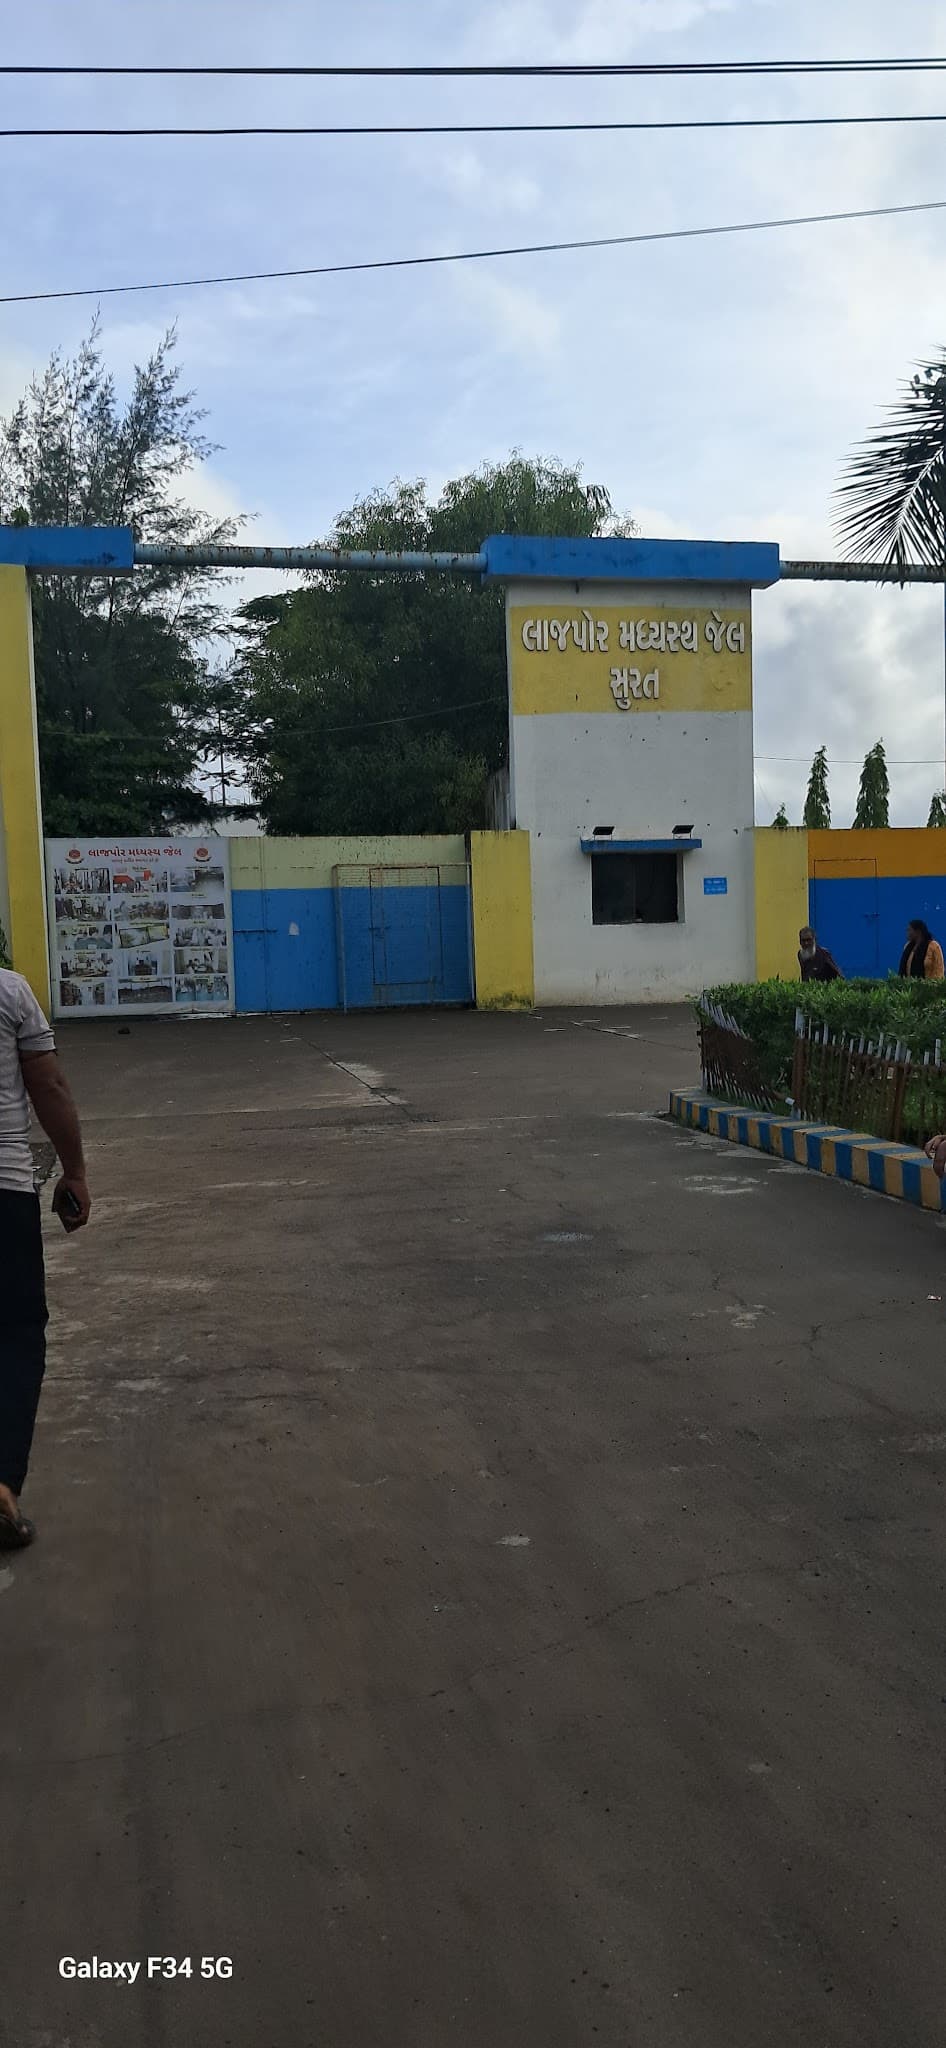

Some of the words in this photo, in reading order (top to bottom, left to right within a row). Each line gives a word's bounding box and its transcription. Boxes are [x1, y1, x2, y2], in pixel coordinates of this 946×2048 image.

[522, 610, 609, 652] લાજપોર
[619, 619, 698, 652] મધ્યસ્થ
[705, 610, 745, 652] જેલ
[610, 667, 660, 710] સુરત
[88, 846, 126, 857] લાજપોર
[163, 846, 182, 856] જેલ
